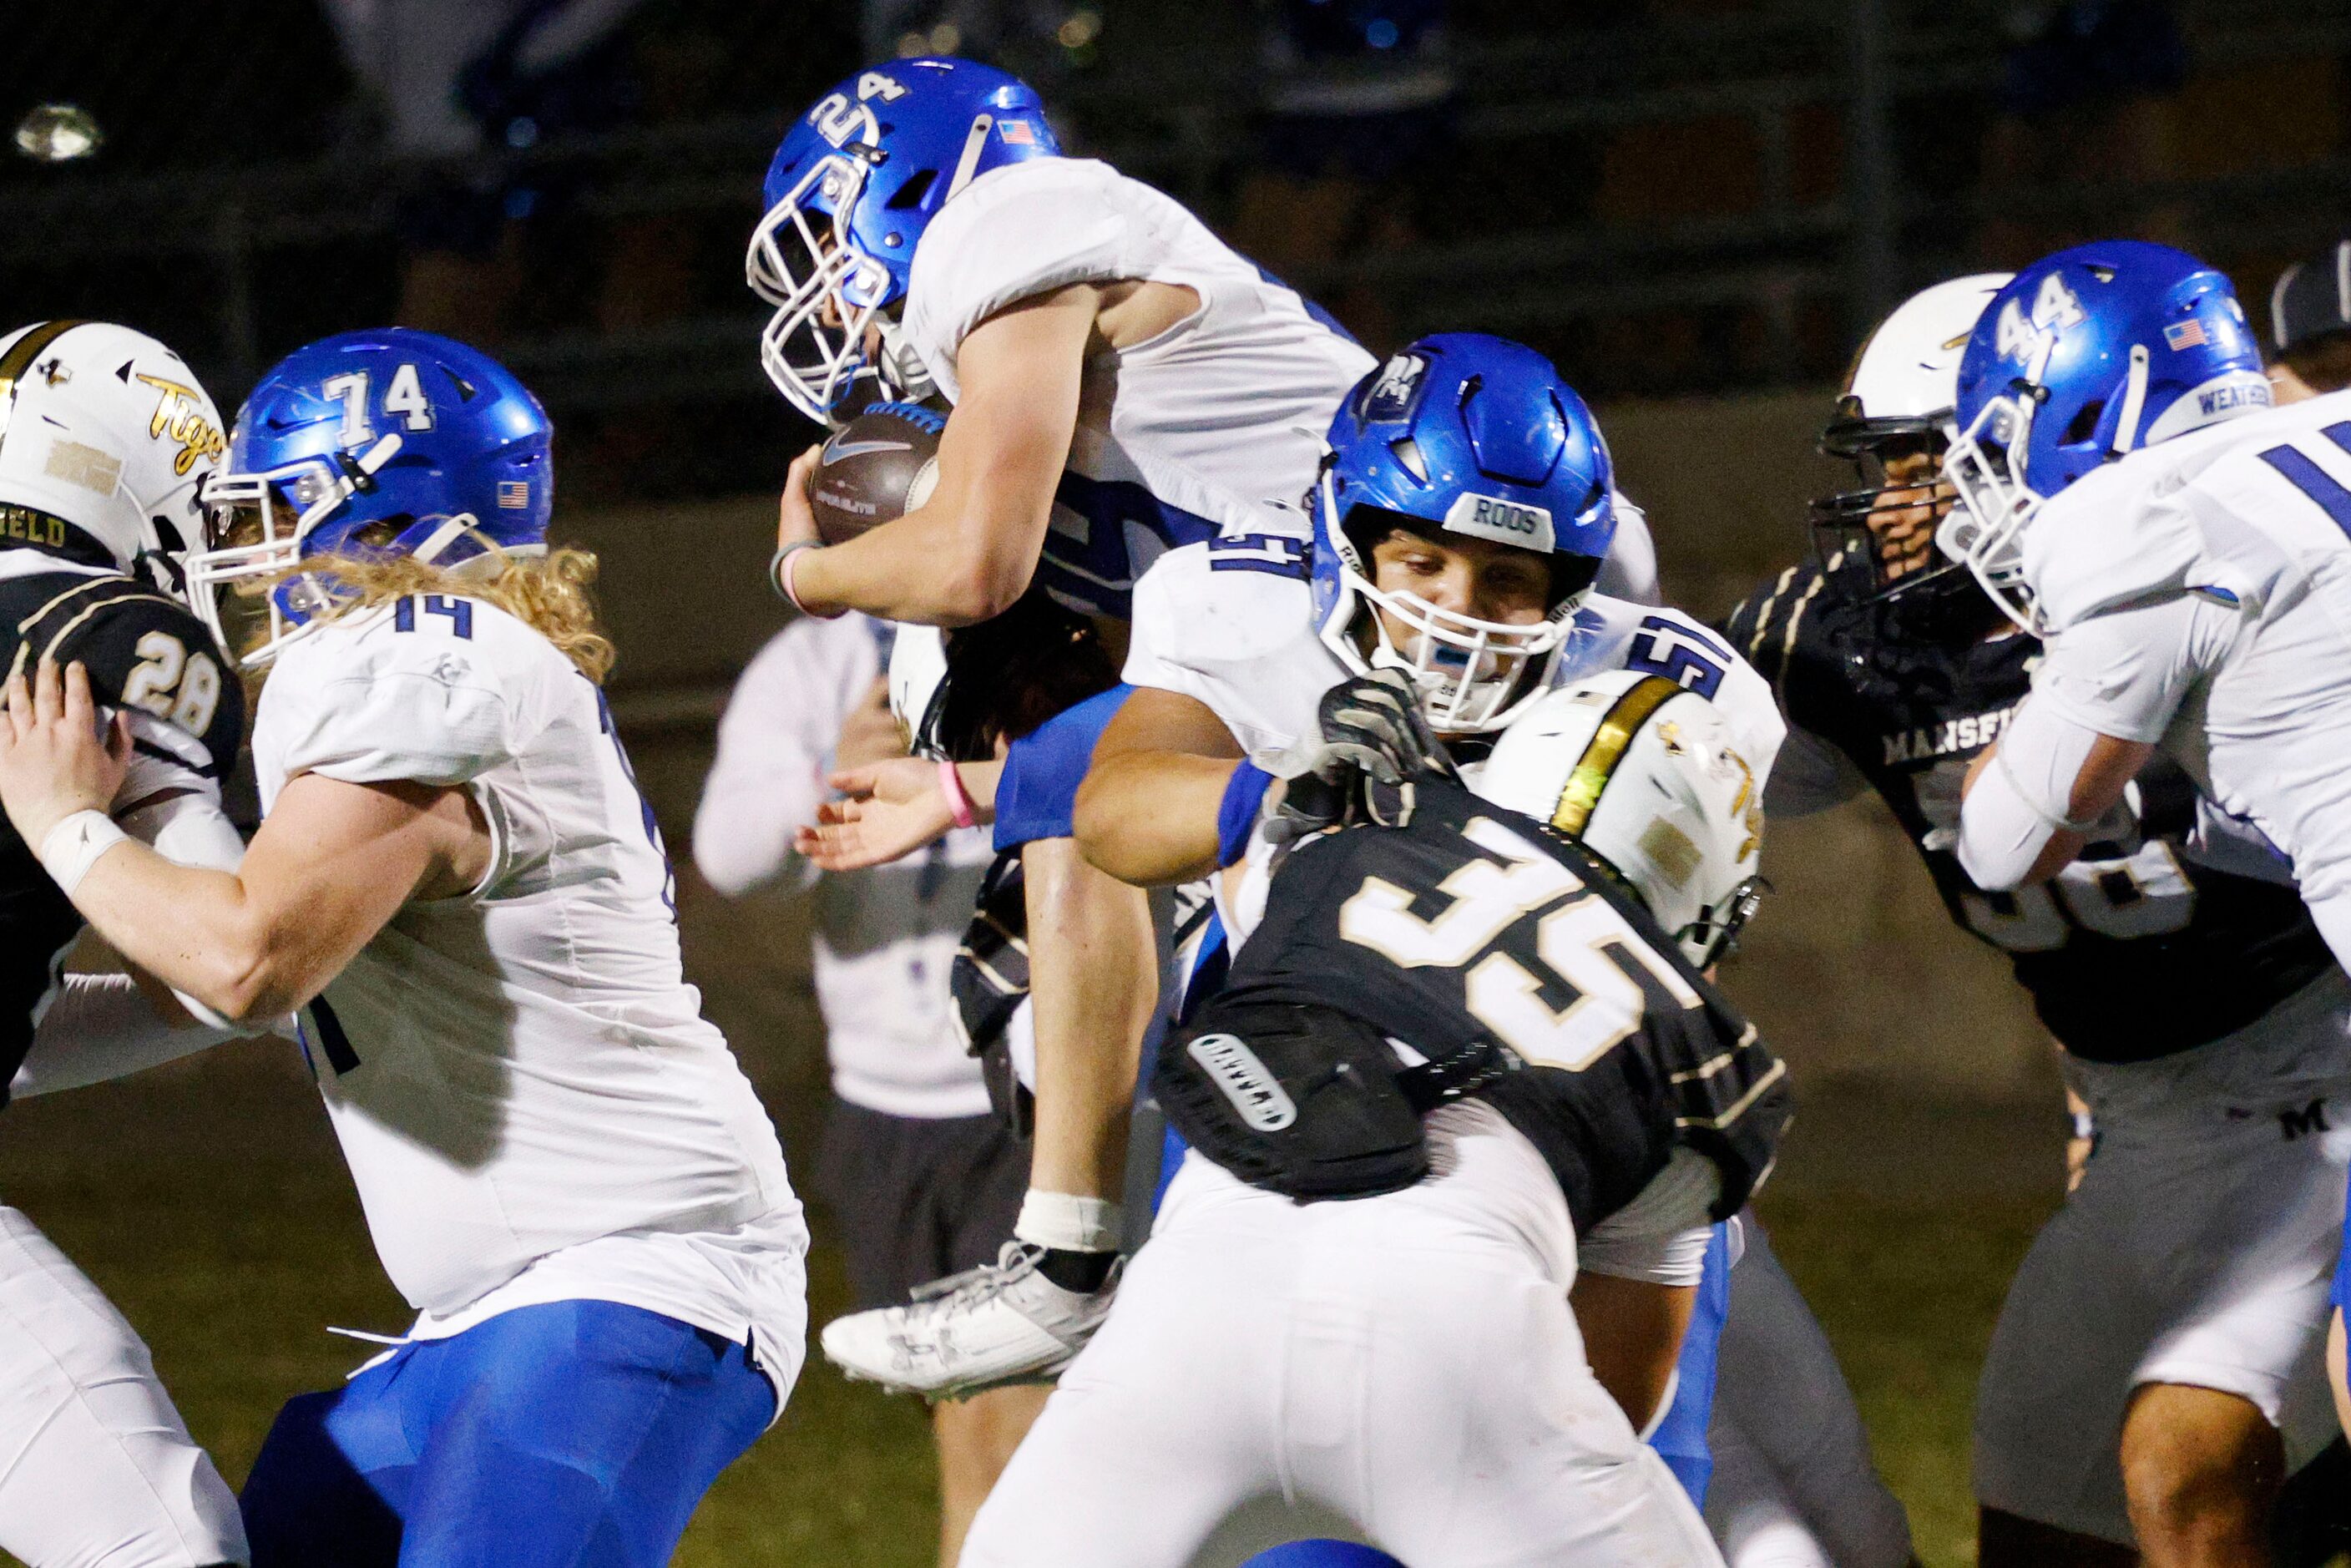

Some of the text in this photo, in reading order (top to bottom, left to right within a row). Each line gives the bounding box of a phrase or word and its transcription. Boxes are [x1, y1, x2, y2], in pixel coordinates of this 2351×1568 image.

[807, 72, 909, 148] 24
[1997, 270, 2086, 366] 44
[323, 363, 433, 453] 74
[1473, 498, 1537, 534] ROOS
[122, 630, 221, 738] 28
[1339, 816, 1705, 1072] 35
